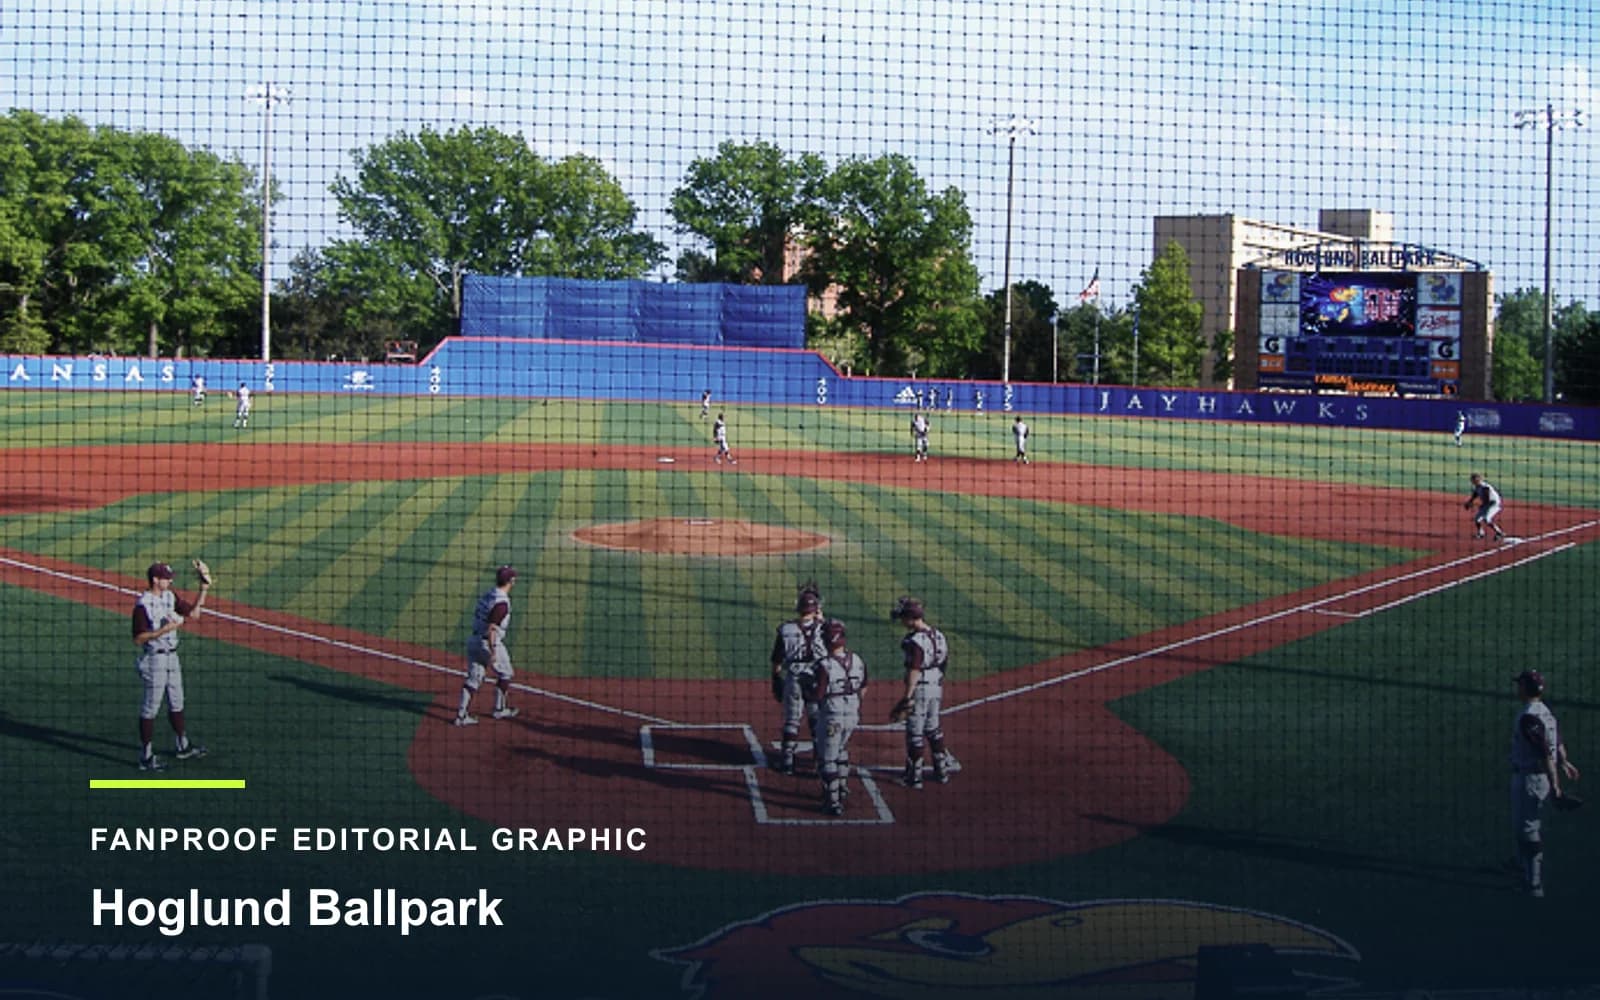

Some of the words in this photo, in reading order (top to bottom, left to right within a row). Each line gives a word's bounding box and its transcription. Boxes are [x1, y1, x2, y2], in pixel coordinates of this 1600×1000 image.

[1265, 337, 1280, 353] G
[1438, 342, 1454, 358] G
[1100, 391, 1369, 421] JAYHAWKS
